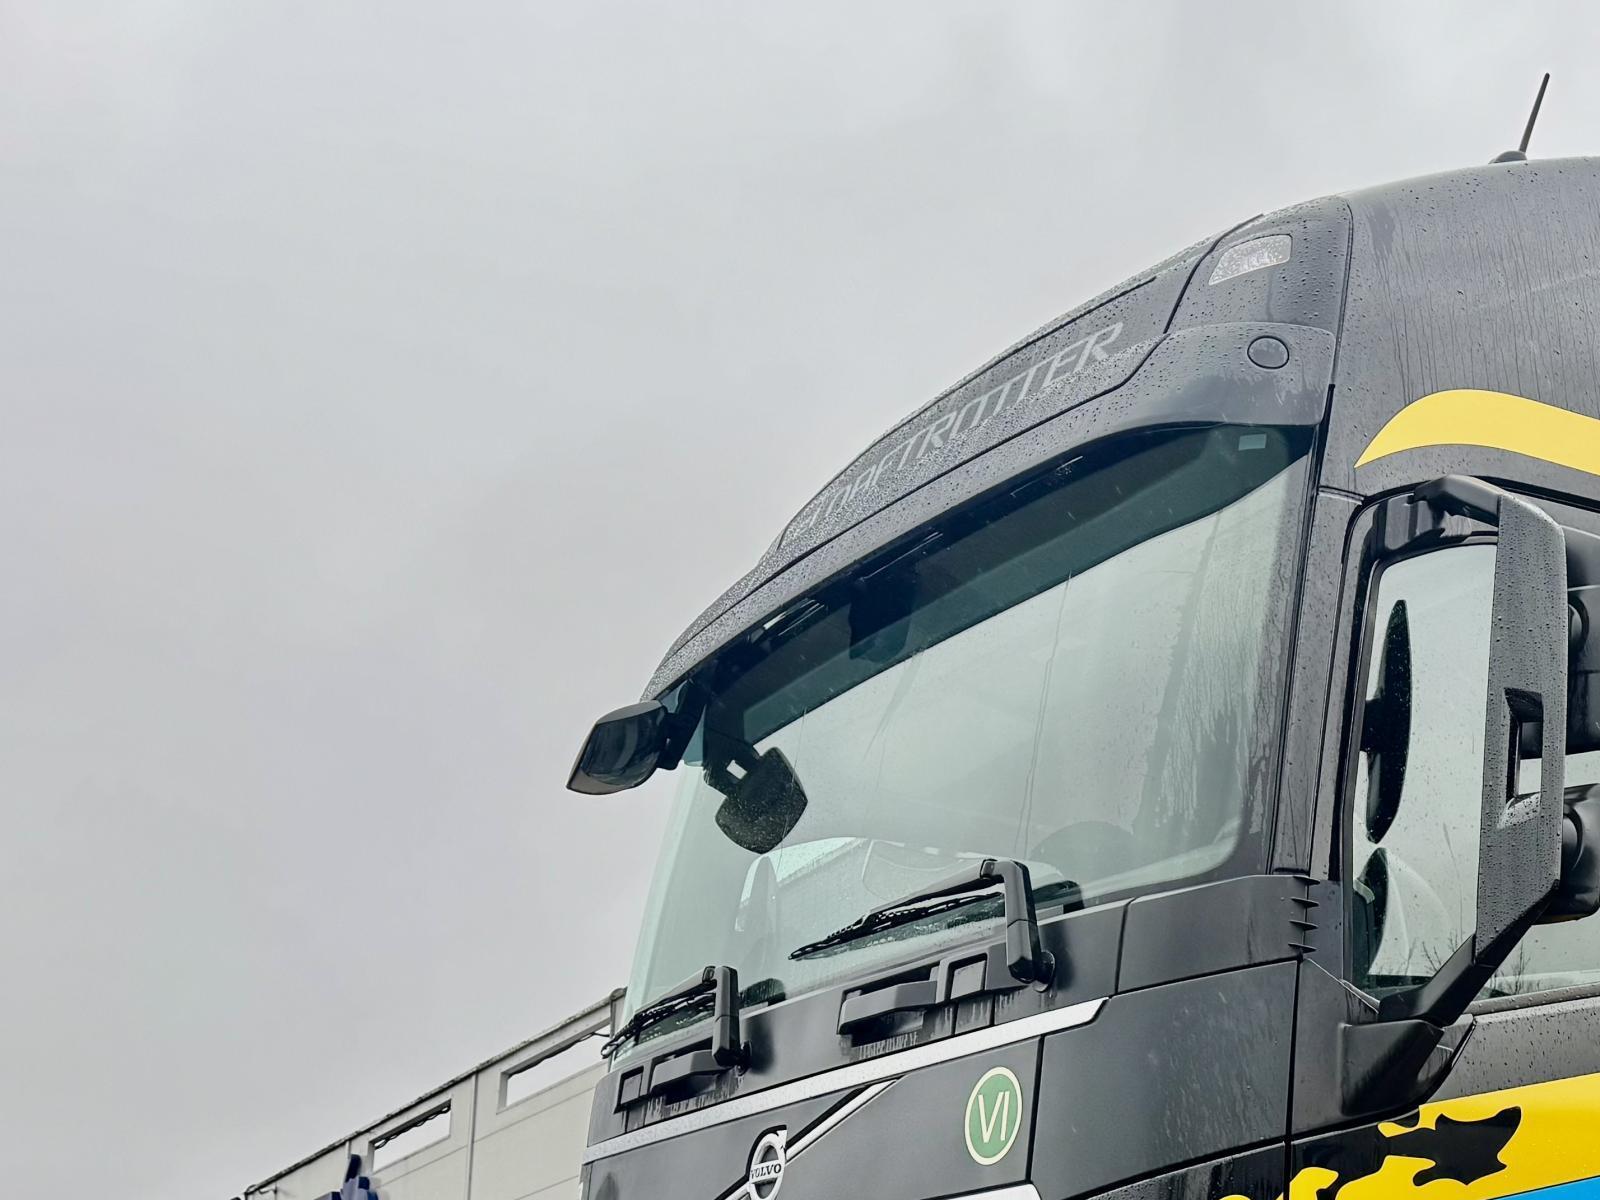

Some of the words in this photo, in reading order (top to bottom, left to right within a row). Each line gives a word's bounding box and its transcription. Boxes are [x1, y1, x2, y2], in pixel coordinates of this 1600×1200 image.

[788, 321, 1124, 538] LOBETROTTER
[977, 1090, 1010, 1144] VI
[750, 1163, 782, 1180] VOLVO
